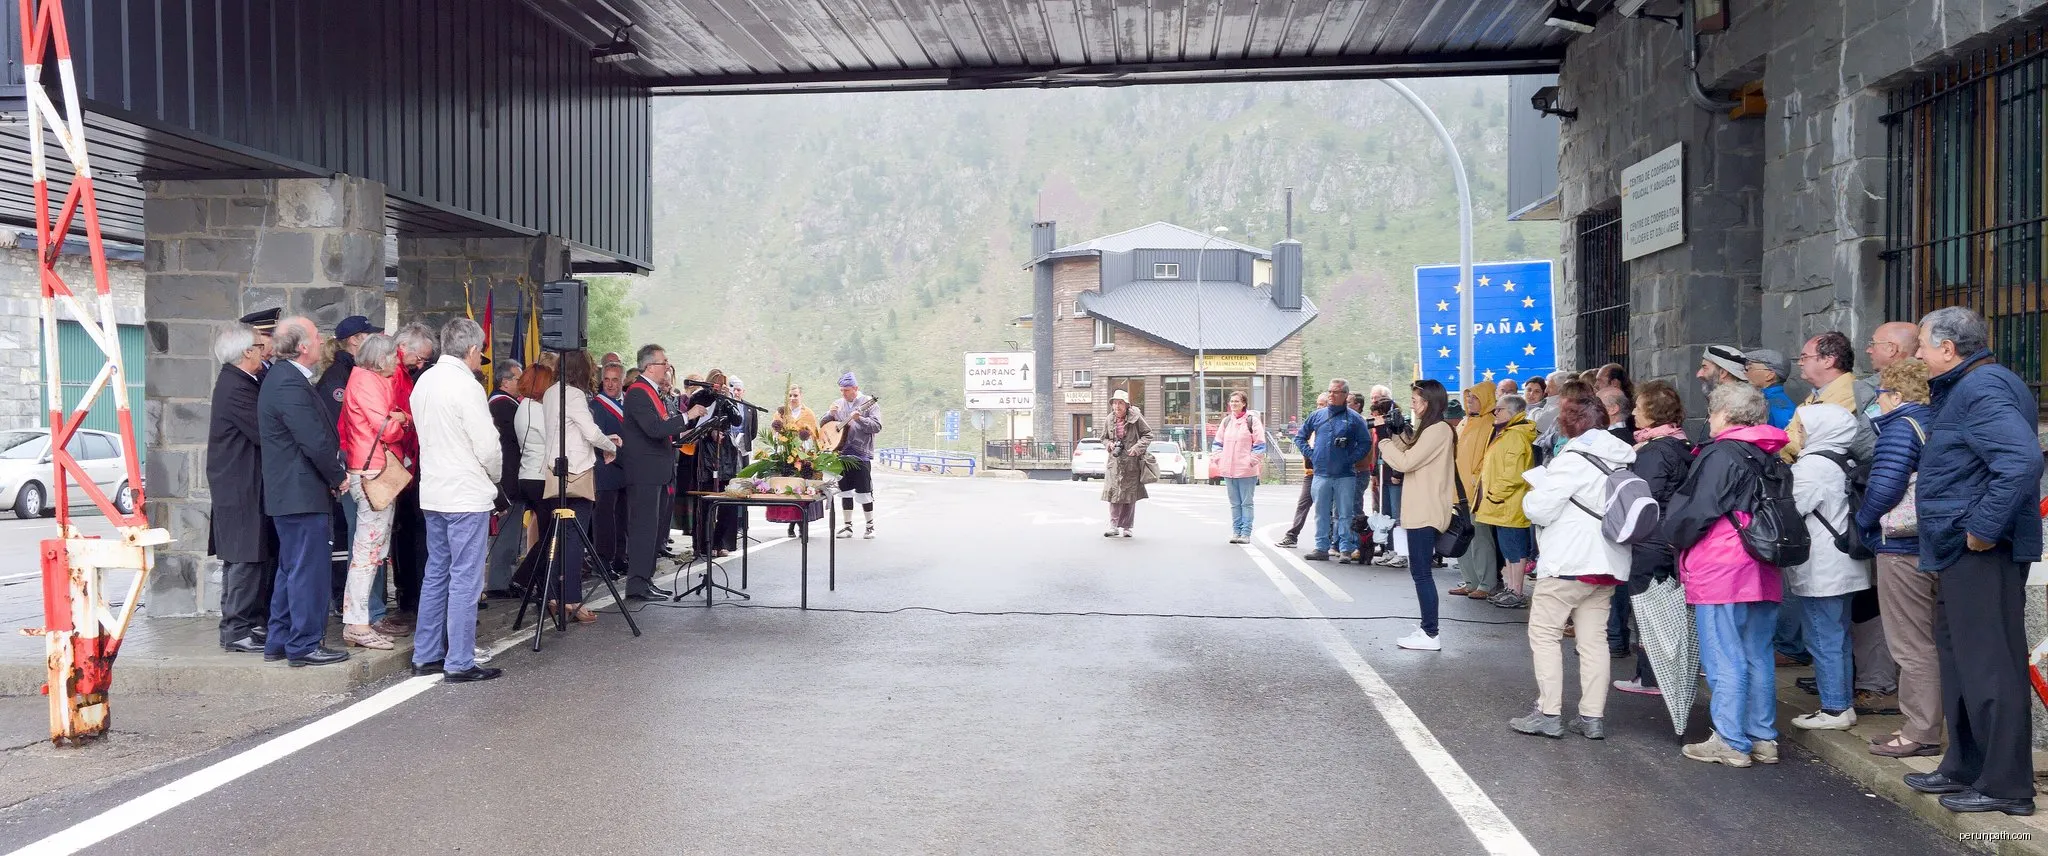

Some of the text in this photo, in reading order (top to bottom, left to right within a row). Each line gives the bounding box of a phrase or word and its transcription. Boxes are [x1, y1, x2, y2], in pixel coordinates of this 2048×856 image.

[1629, 173, 1644, 188] CENTRO
[1644, 170, 1650, 181] DE
[1632, 185, 1649, 200] POLICIAL
[1629, 218, 1644, 232] CENTRE
[1644, 216, 1650, 226] DE
[1649, 229, 1654, 239] ET
[1447, 318, 1526, 336] EPAÑA
[968, 368, 1016, 376] CANFRANC
